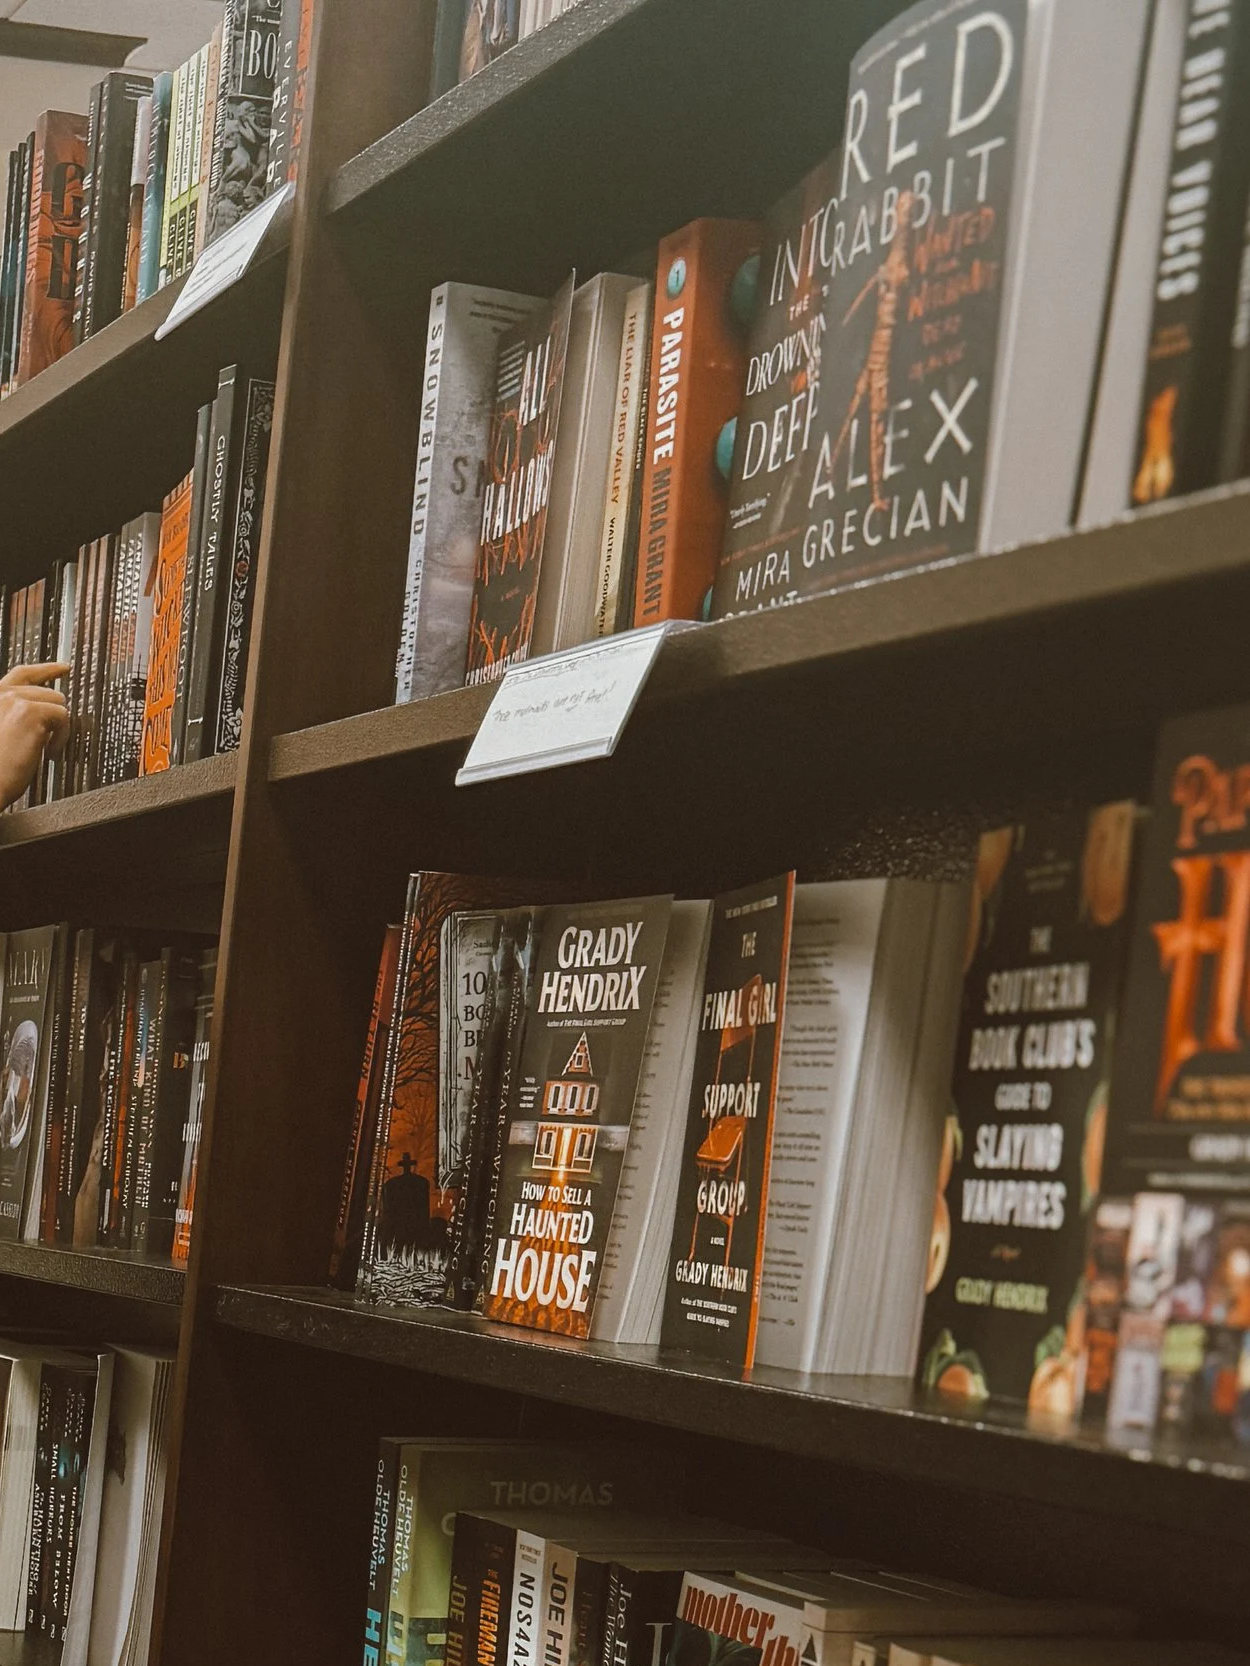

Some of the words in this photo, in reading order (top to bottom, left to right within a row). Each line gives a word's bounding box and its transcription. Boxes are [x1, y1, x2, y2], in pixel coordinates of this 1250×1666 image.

[272, 39, 294, 189] EVERVILLE
[840, 11, 1015, 203] RED
[830, 136, 1007, 278] RABBIT
[86, 250, 96, 291] DAVID
[626, 311, 637, 344] THE
[519, 334, 551, 427] ALL
[622, 347, 633, 383] LIAR
[652, 306, 686, 466] PARASITE
[620, 386, 629, 409] OF
[413, 321, 444, 537] SNOWBLIND
[616, 411, 627, 443] RED
[807, 376, 980, 510] ALEX
[209, 434, 225, 523] GHOSTLY
[480, 440, 554, 547] HALLOWS
[609, 446, 624, 505] VALLEY
[647, 467, 673, 534] MIRA
[604, 516, 616, 563] WALTER
[801, 475, 970, 569] GRECIAN
[203, 531, 218, 593] TALES
[641, 534, 671, 618] GRANT
[735, 549, 791, 602] MIRA
[175, 555, 194, 703] SLEWFOOT
[557, 920, 645, 970] GRADY
[740, 930, 757, 959] THE
[1030, 926, 1053, 954] THE
[536, 965, 648, 1014] HENDRIX
[701, 987, 744, 1032] FINAL
[746, 980, 778, 1028] GIRL
[986, 962, 1091, 1014] SOUTHERN
[968, 1026, 1018, 1070] BOOK
[1021, 1018, 1097, 1069] CLUB'S
[701, 1077, 762, 1121] SUPPORT
[994, 1083, 1031, 1110] GUIDE
[1034, 1082, 1052, 1110] TO
[973, 1123, 1065, 1172] SLAYING
[449, 1151, 473, 1271] WITCHING
[479, 1152, 502, 1274] WITCHING
[521, 1180, 548, 1203] HOW
[547, 1184, 561, 1204] TO
[561, 1184, 583, 1206] SELL
[583, 1188, 592, 1207] A
[961, 1178, 1068, 1230] VAMPIRES
[509, 1200, 595, 1245] HAUNTED
[489, 1238, 598, 1314] HOUSE
[674, 1257, 709, 1286] GRADY
[710, 1263, 748, 1295] HENDRIX
[374, 1458, 384, 1506] OLDE
[397, 1464, 407, 1513] OLDE
[490, 1480, 614, 1506] THOMAS
[368, 1510, 380, 1590] HEUVELT
[377, 1489, 390, 1565] THOMAS
[400, 1496, 413, 1571] THOMAS
[391, 1517, 403, 1598] HEUVELT
[449, 1574, 468, 1624] JOE
[547, 1561, 570, 1630] JOE
[618, 1582, 633, 1630] Joe
[681, 1583, 778, 1650] mother
